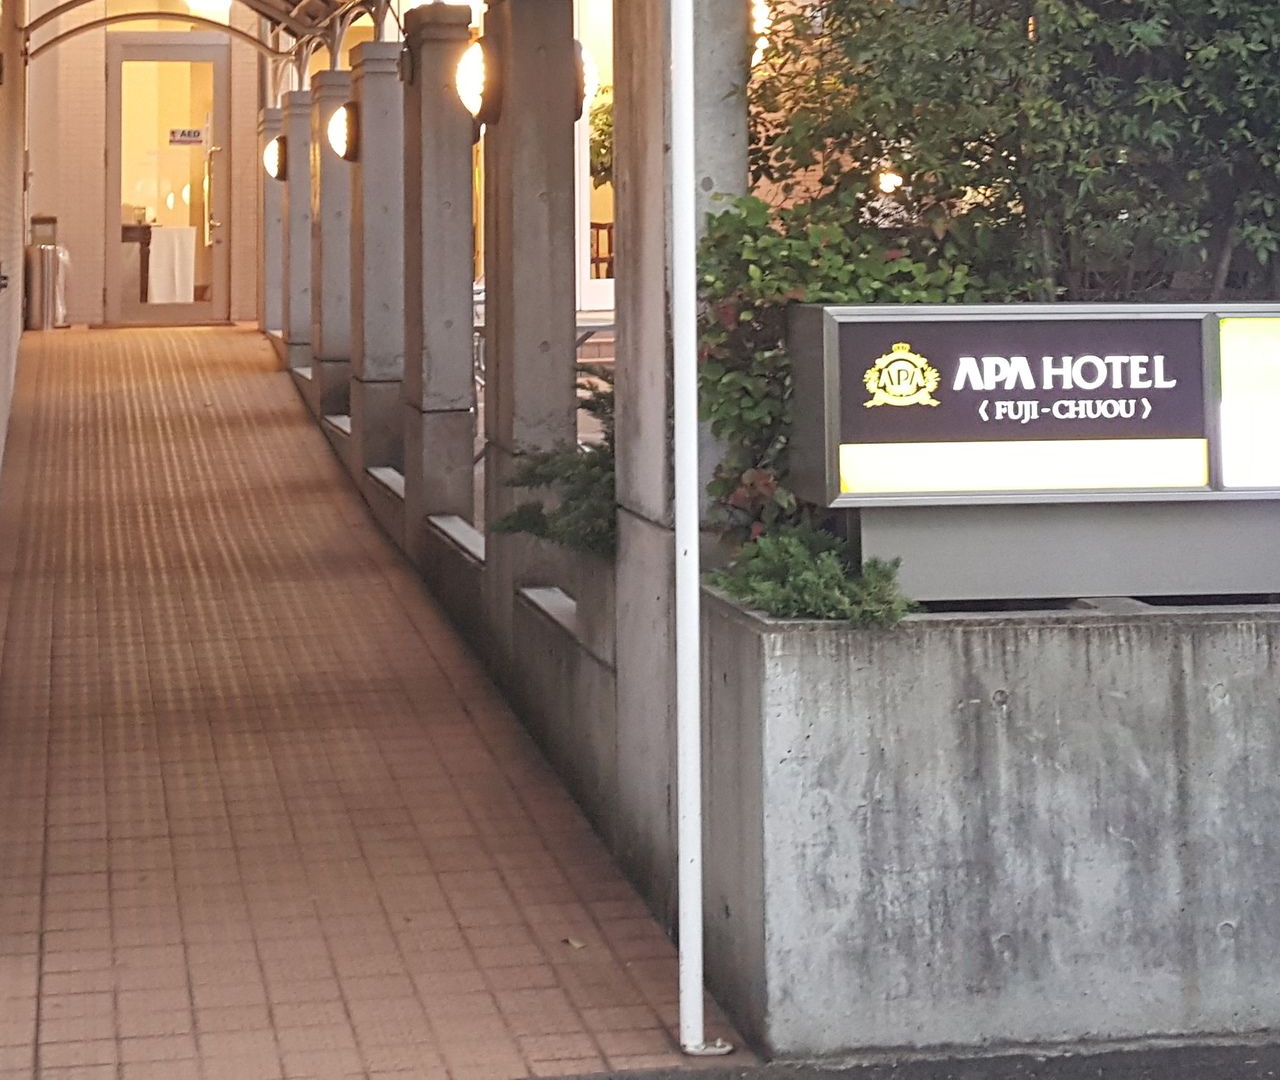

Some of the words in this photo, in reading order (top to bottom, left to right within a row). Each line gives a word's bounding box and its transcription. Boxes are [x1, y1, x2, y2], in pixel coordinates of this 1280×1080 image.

[179, 129, 201, 138] AED
[953, 355, 1036, 391] APA
[1042, 354, 1177, 390] HOTEL
